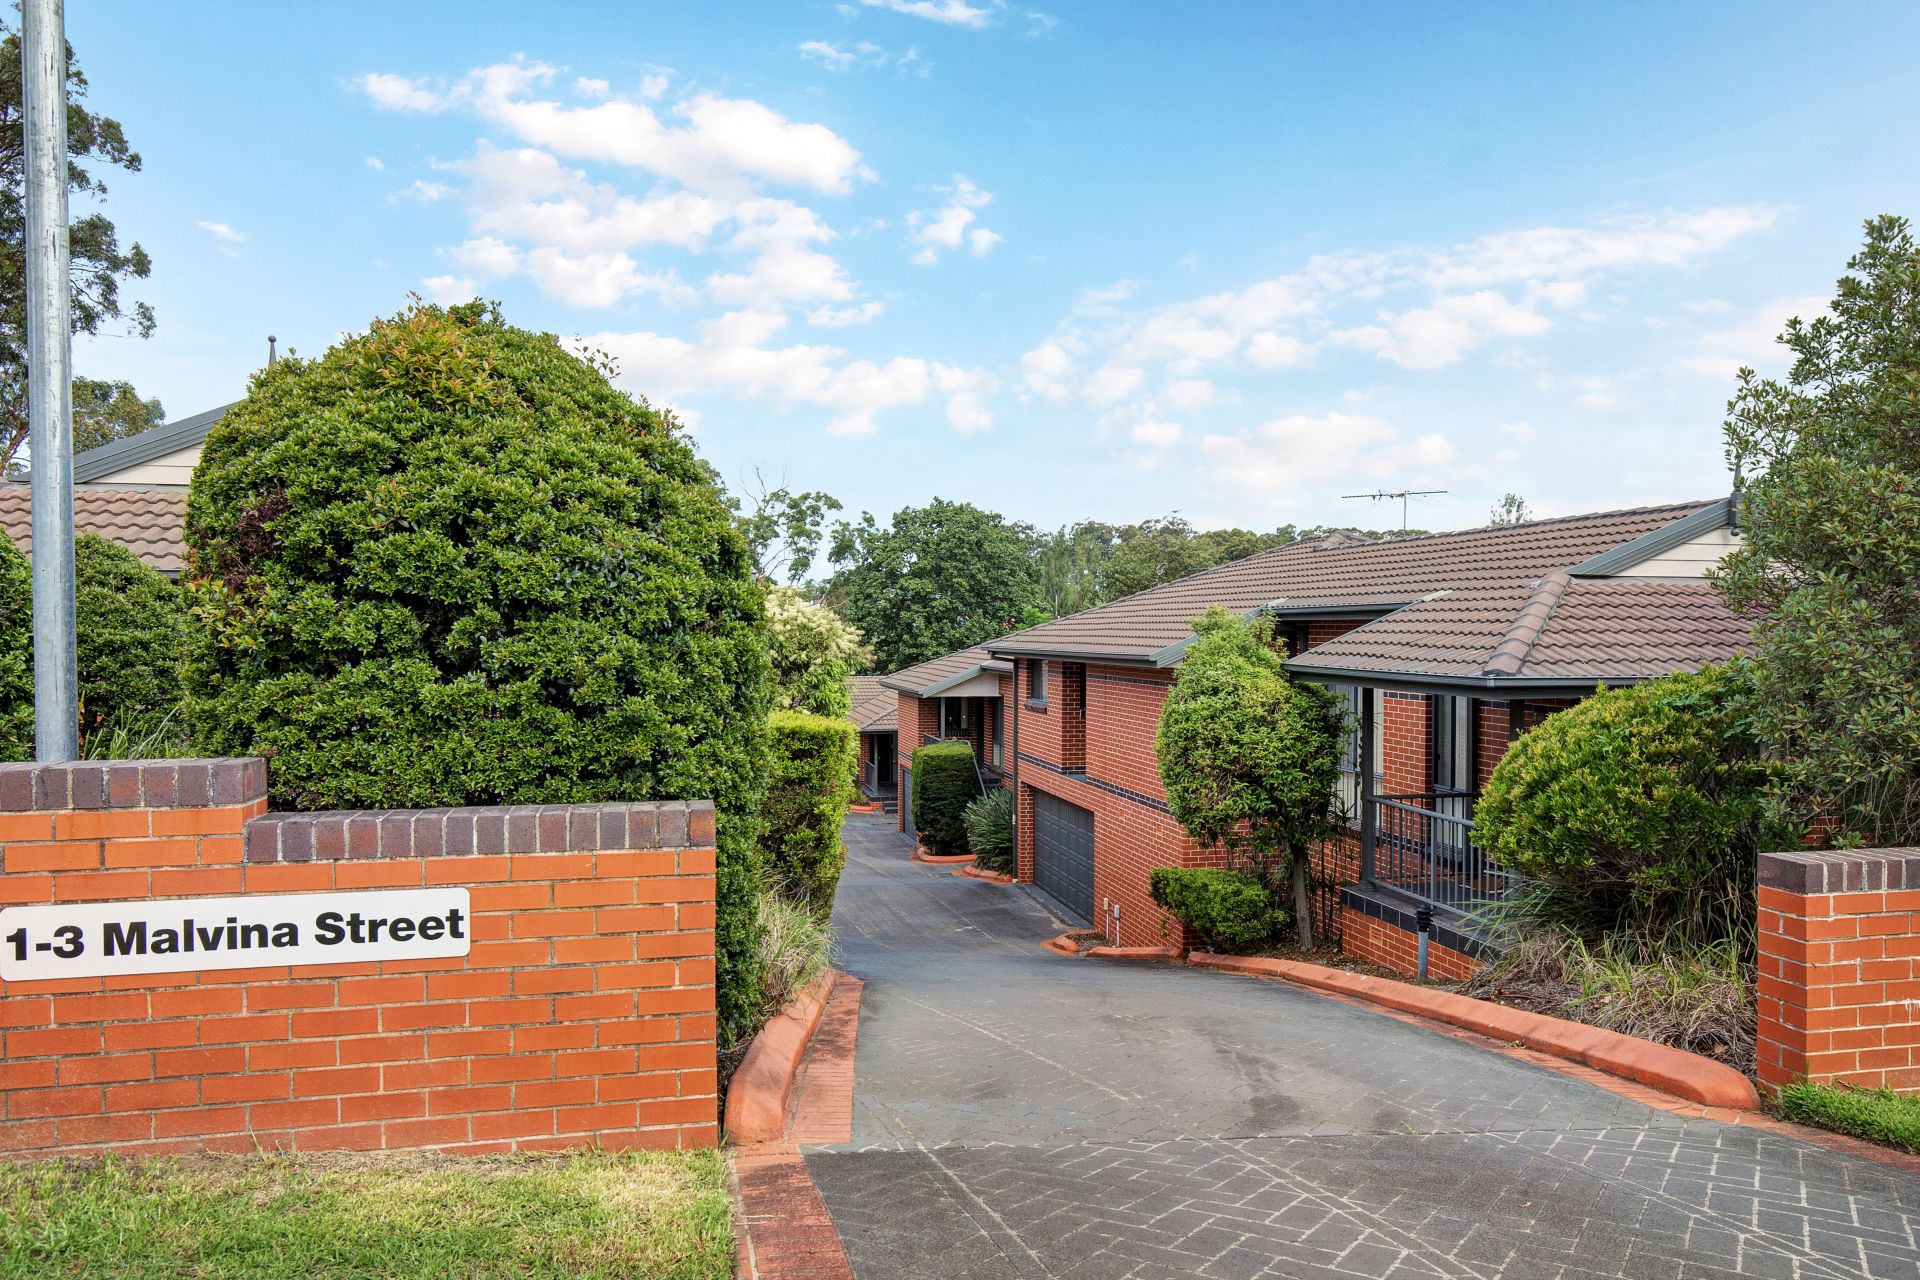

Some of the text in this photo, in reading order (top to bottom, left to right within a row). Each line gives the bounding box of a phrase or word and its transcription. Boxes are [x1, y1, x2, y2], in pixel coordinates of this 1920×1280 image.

[6, 908, 465, 961] 1-3 Malvina Street
